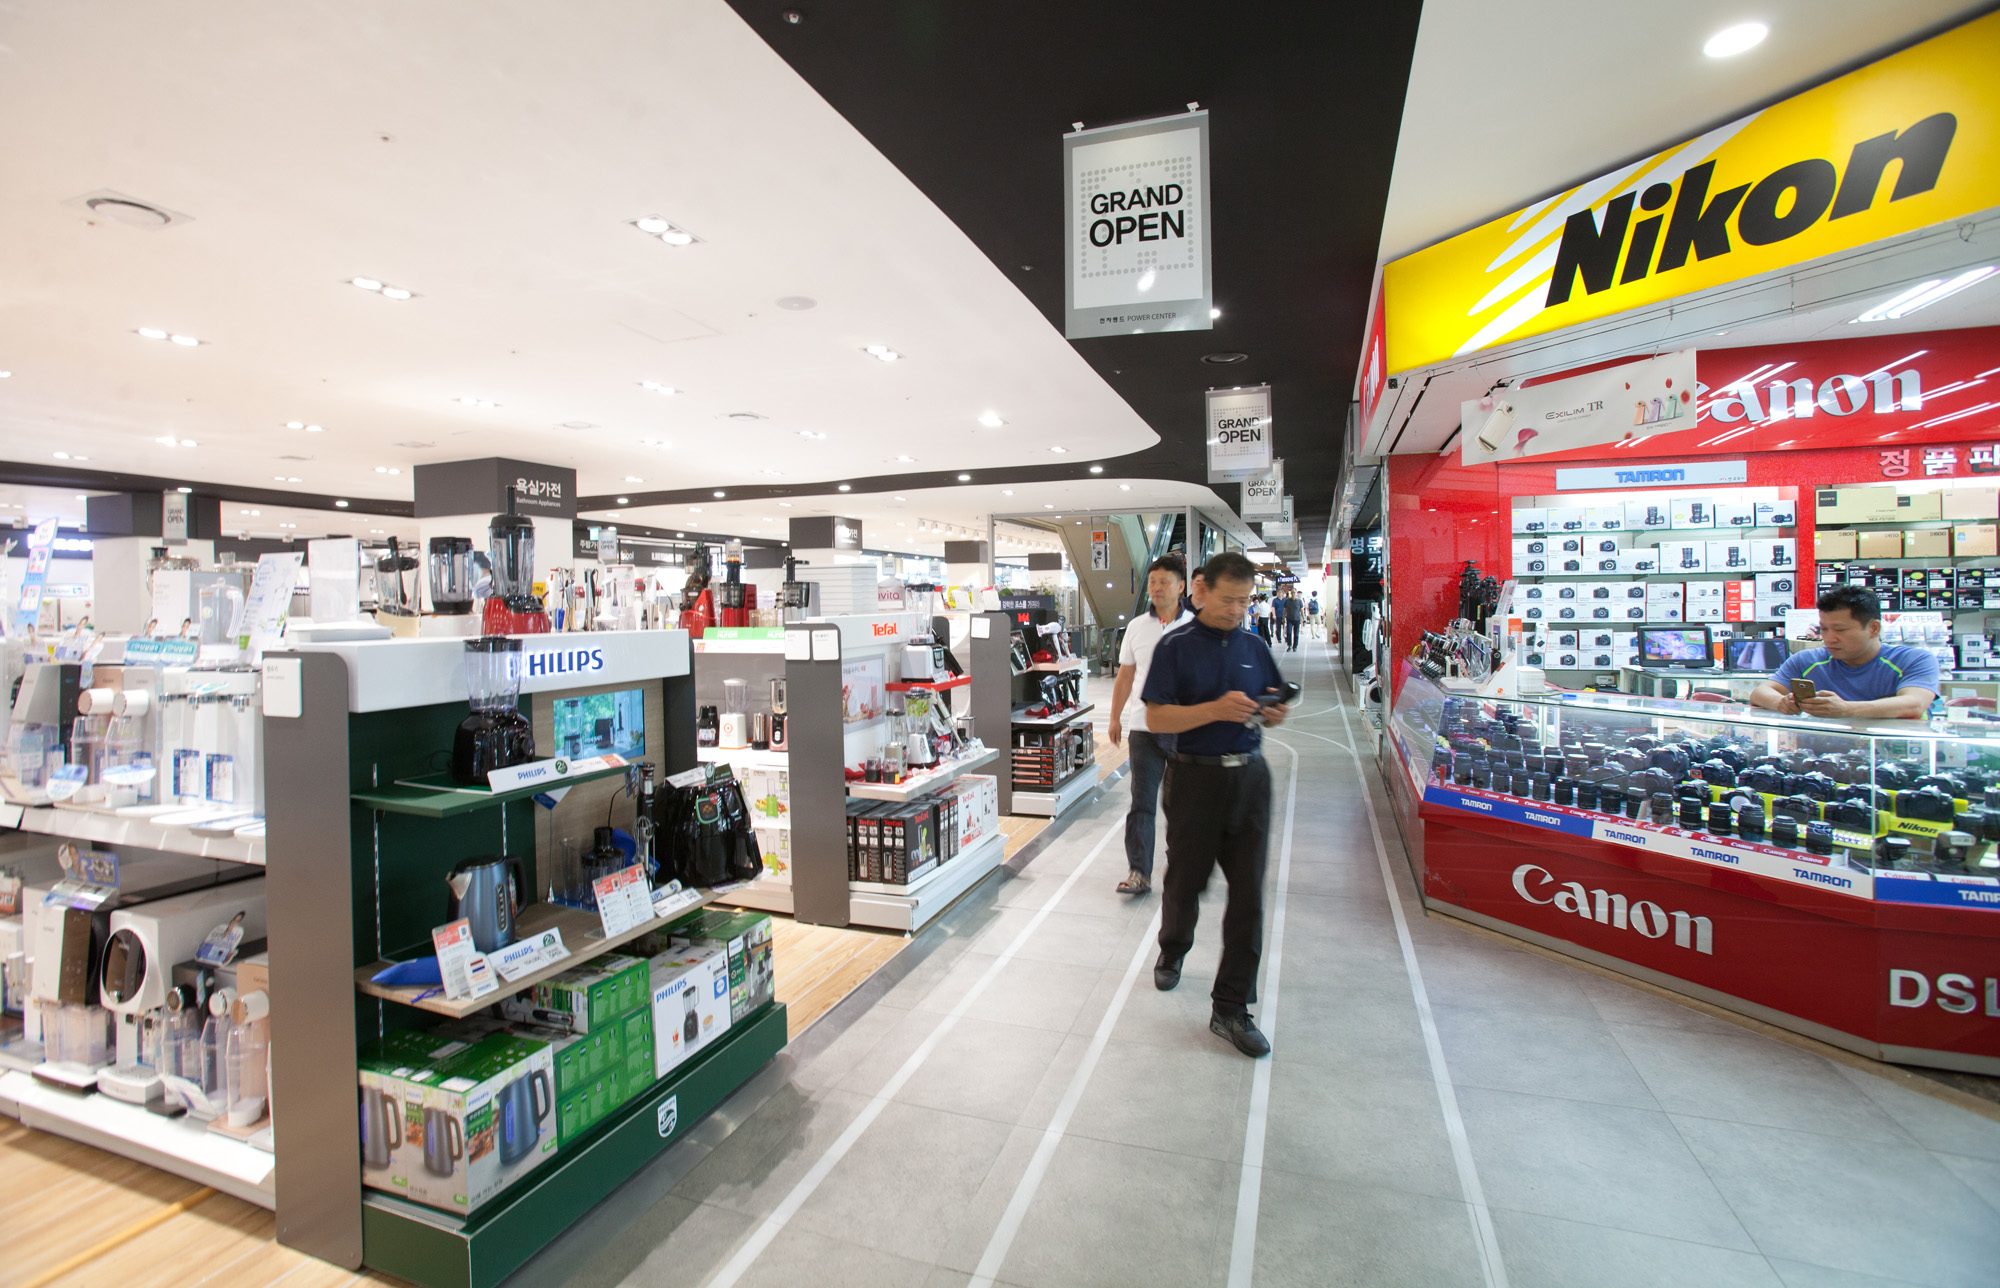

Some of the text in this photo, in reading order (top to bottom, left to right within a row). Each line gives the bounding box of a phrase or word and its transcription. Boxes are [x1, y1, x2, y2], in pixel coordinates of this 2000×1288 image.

[1090, 183, 1184, 215] GRAND
[1545, 112, 1957, 308] Nikon
[1089, 209, 1185, 248] OPEN
[1127, 314, 1151, 322] POWER
[1151, 312, 1177, 320] CENTER
[1696, 368, 1922, 424] anon
[1545, 408, 1585, 420] EXILIM
[1586, 400, 1604, 412] TR
[1218, 417, 1260, 429] GRAND
[1218, 428, 1261, 444] OPEN
[1615, 468, 1685, 483] TAMRON
[515, 477, 562, 499] 욕실가전
[1248, 479, 1276, 488] GRAND
[1247, 487, 1277, 497] OPEN
[167, 515, 184, 524] OPEN
[1903, 615, 1940, 624] FILTERS
[872, 622, 898, 637] Tefal
[517, 766, 547, 781] PHILIPS
[1461, 797, 1493, 811] TAMRON
[883, 819, 904, 827] Tefal
[914, 810, 929, 825] Tefal
[1524, 811, 1561, 826] TAMRON
[1897, 821, 1939, 835] Nikon
[1604, 829, 1646, 844] TAMRON
[1730, 842, 1754, 850] Canon
[1763, 848, 1788, 857] Canon
[1690, 846, 1739, 865] TAMRON
[1797, 855, 1824, 864] Canon
[1792, 867, 1852, 889] TAMRON
[1884, 871, 1917, 880] Canon
[1951, 877, 1986, 885] Canon
[1512, 863, 1714, 956] Canon
[503, 944, 534, 963] PHILIPS
[656, 977, 688, 1004] PHILIPS
